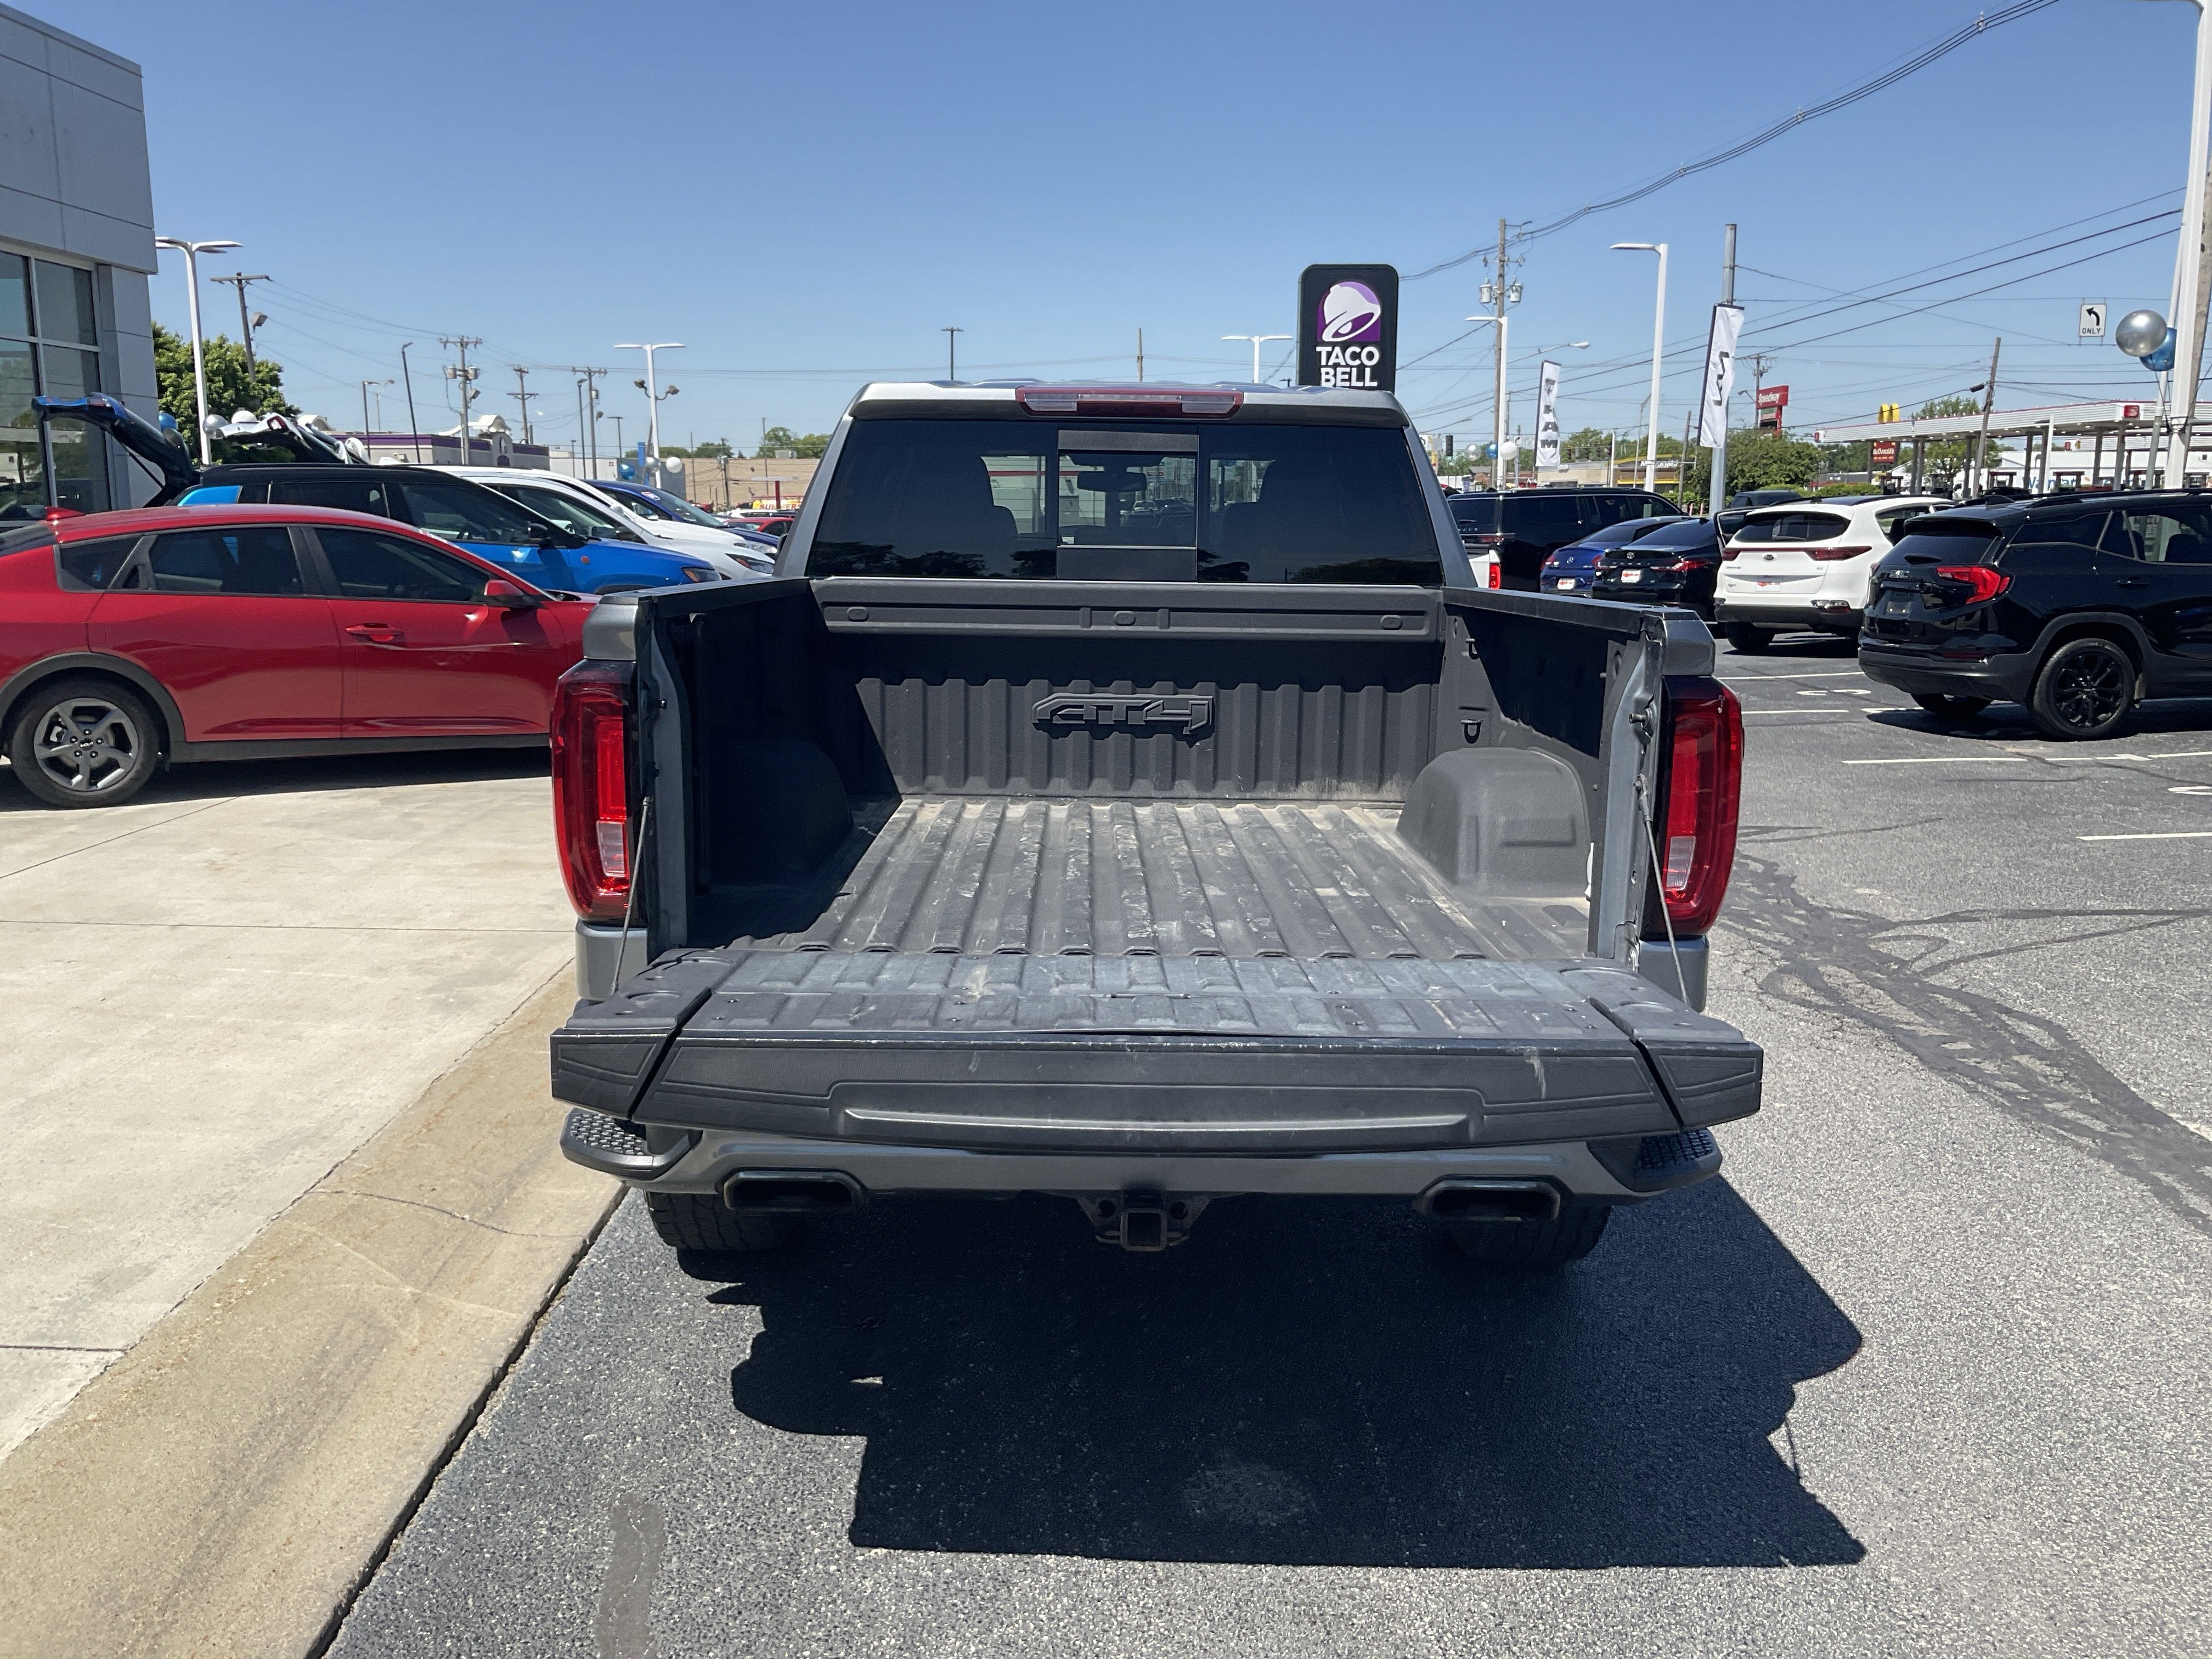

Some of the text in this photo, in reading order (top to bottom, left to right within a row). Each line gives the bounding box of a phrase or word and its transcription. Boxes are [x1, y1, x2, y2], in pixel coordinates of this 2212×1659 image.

[1316, 346, 1380, 366] TACO
[1321, 367, 1378, 387] BELL
[1758, 392, 1780, 405] Speedway
